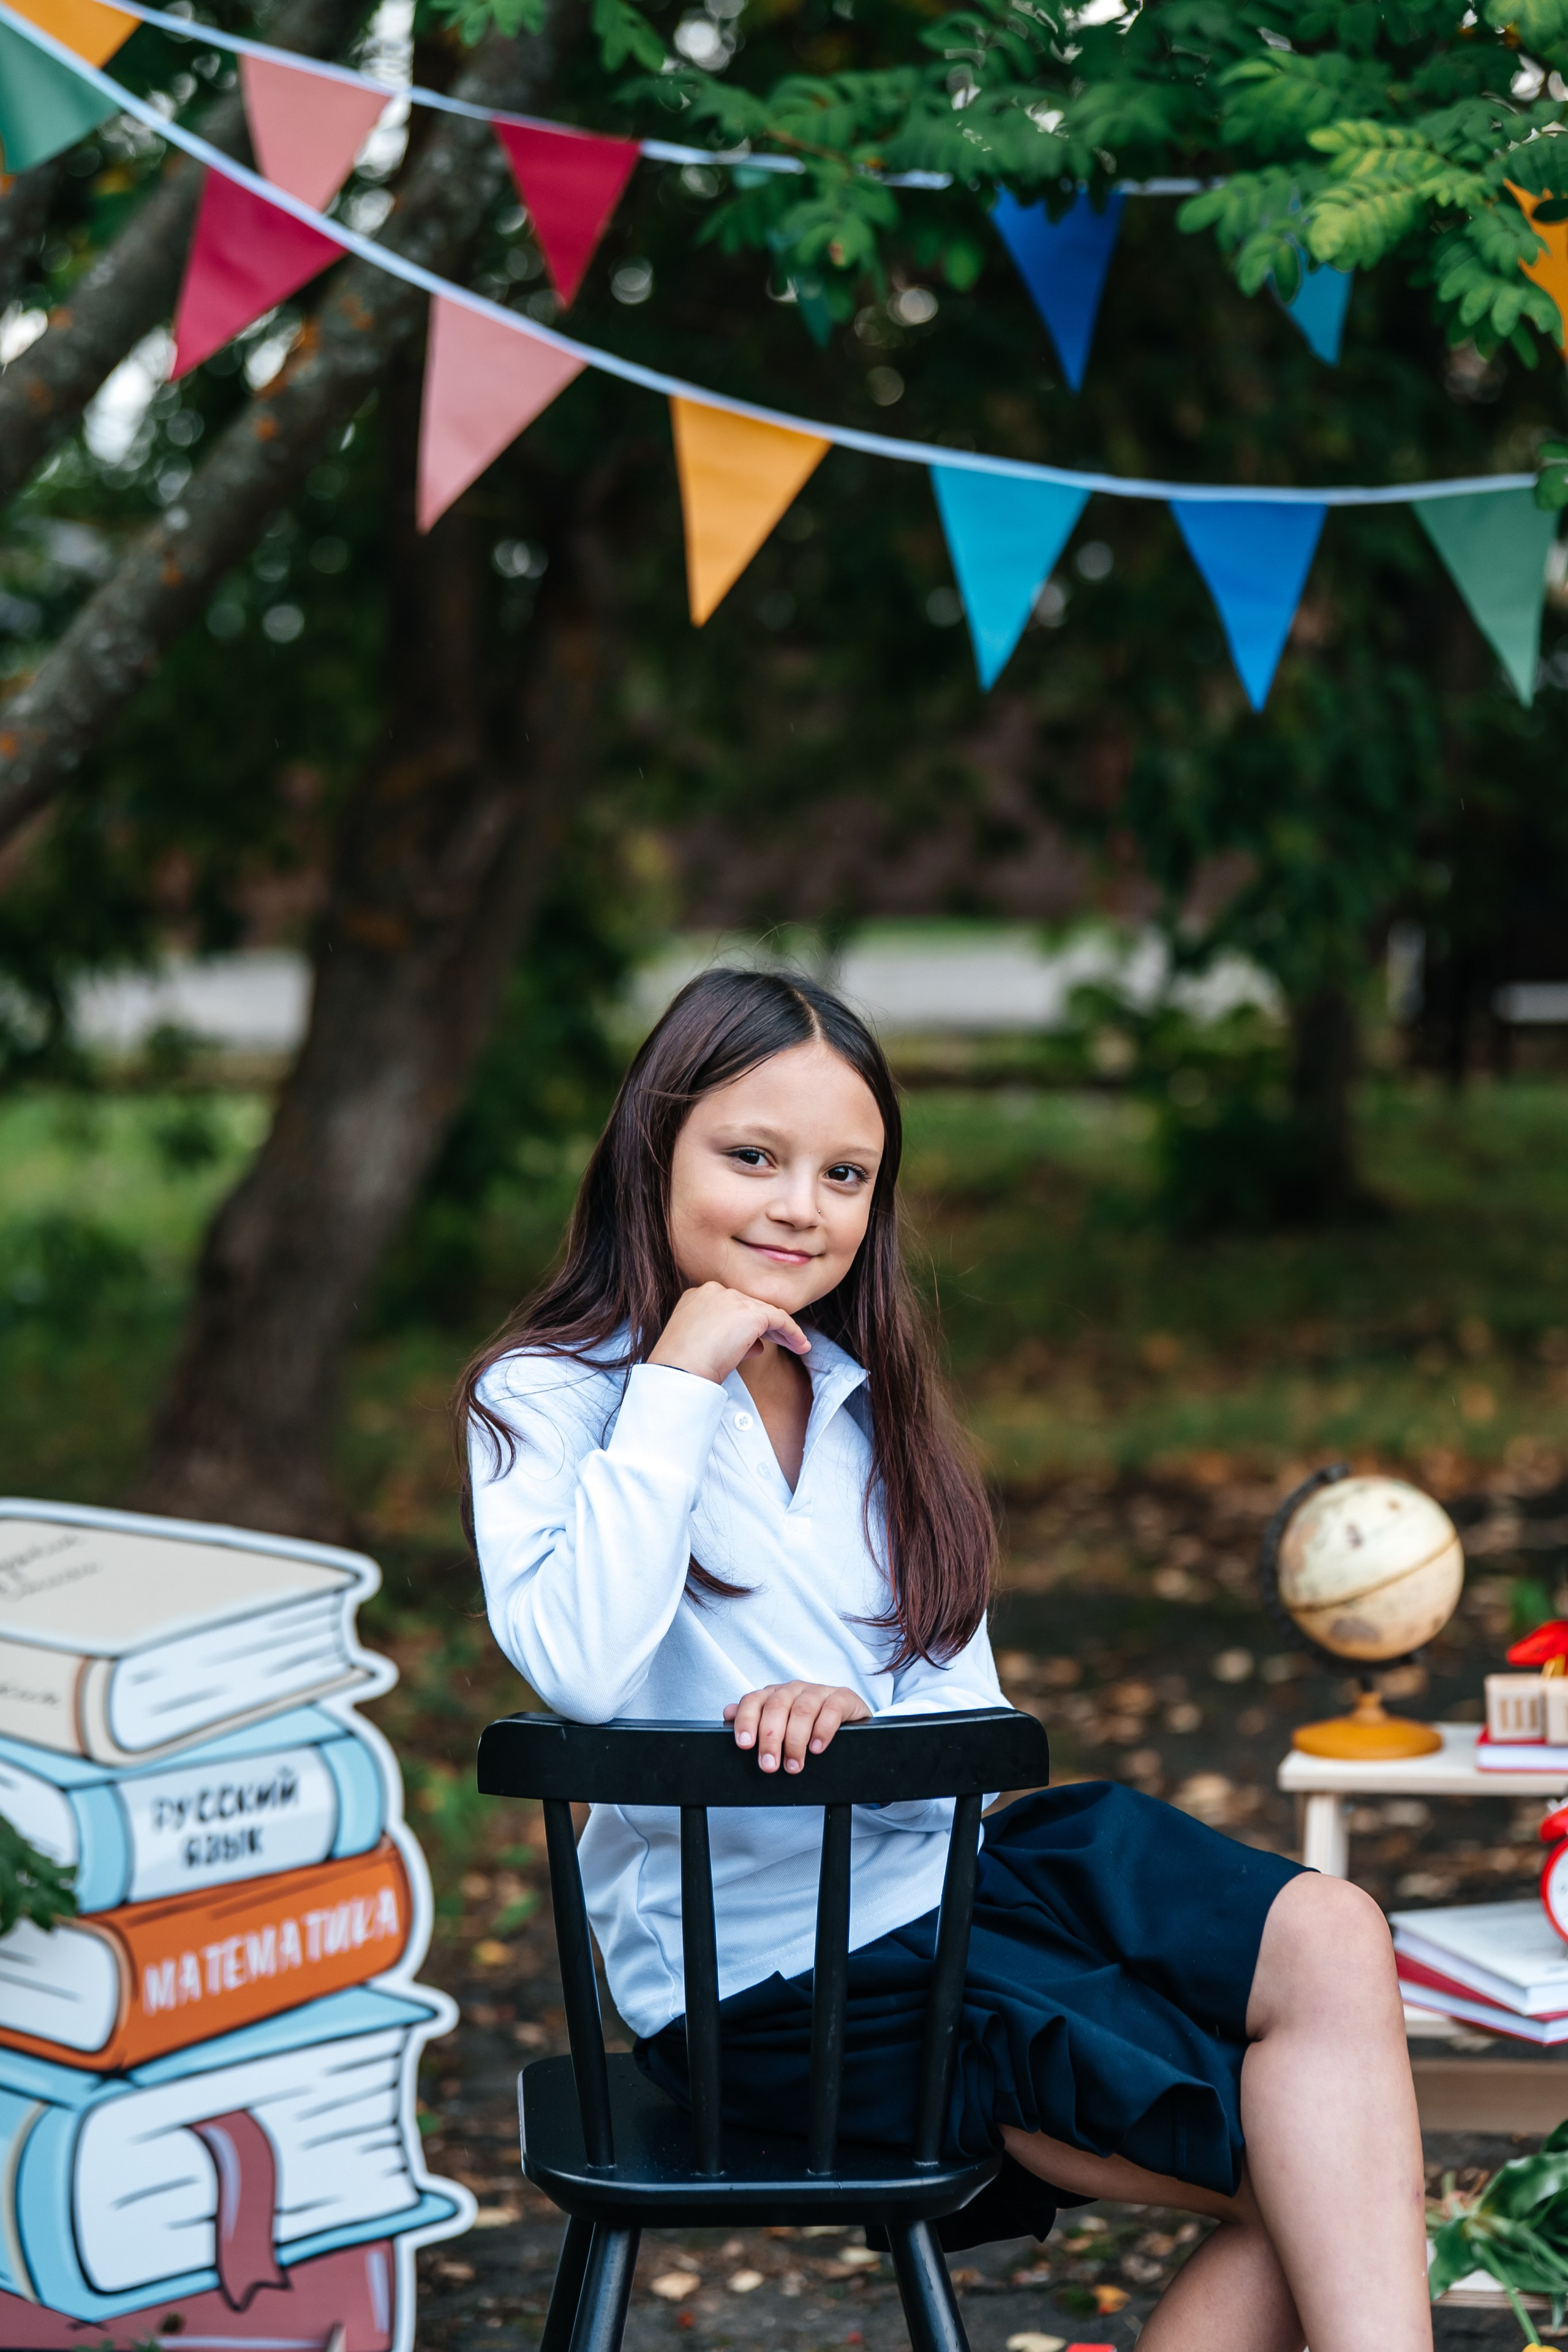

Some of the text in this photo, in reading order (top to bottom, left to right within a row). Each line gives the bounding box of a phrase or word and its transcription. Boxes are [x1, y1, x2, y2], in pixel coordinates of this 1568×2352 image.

[153, 1766, 298, 1830] РУССКИЙ
[185, 1827, 262, 1867] ЯЗЫК
[143, 1888, 398, 2015] МАТЕМАТИКА
